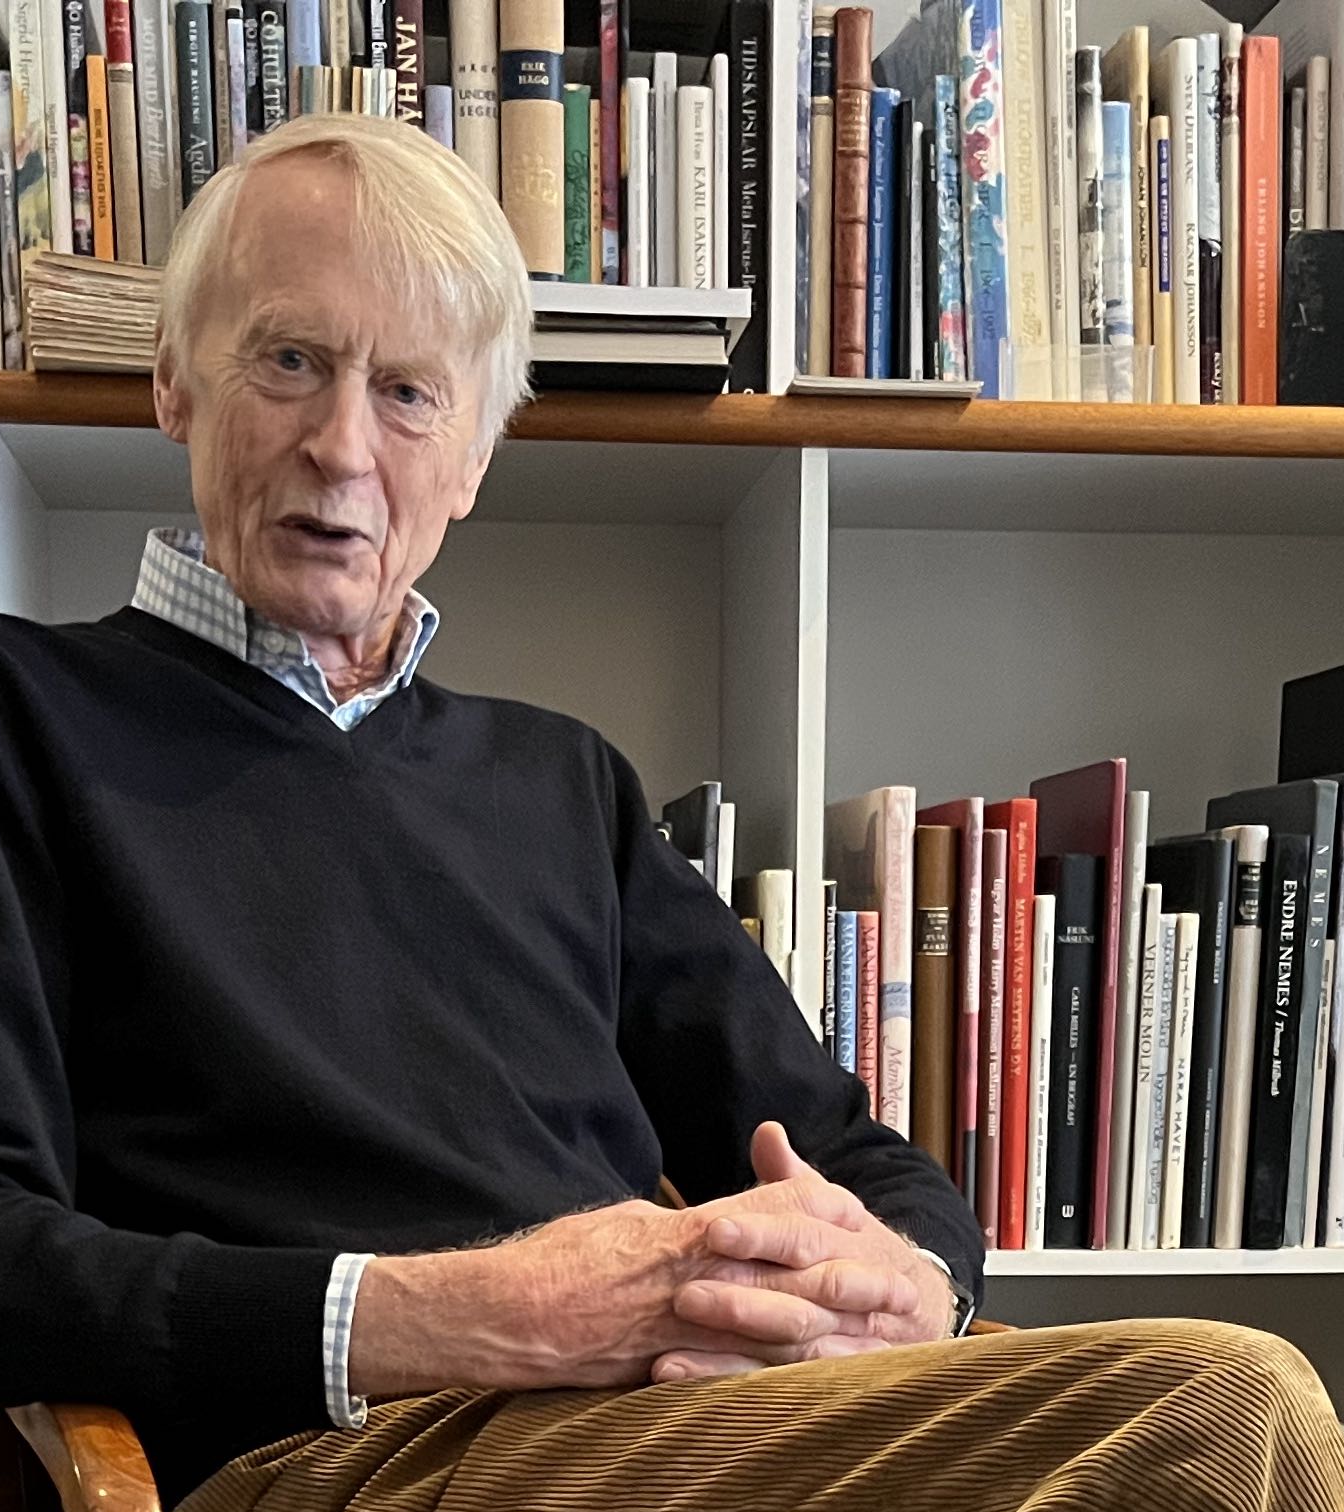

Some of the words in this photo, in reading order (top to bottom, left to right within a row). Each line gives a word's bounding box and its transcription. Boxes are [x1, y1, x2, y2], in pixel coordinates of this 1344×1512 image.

[17, 1, 35, 44] Sigrid
[395, 16, 417, 73] JAN
[190, 69, 200, 124] RAUSING
[741, 37, 758, 170] TIDSKAPSLAR
[185, 133, 209, 184] Agda
[694, 166, 707, 211] KARL
[741, 180, 757, 219] Meta
[693, 216, 706, 290] ISAKSON
[1014, 899, 1025, 952] MARTIN
[1281, 880, 1297, 941] ENDRE
[1309, 844, 1329, 950] NEMES
[861, 926, 876, 1054] MANDELGREN
[988, 959, 1000, 990] Harry
[1013, 956, 1024, 983] VAN
[1141, 944, 1156, 1019] VERNER
[1276, 945, 1294, 1006] NEMES
[988, 995, 1000, 1053] Martinson
[1139, 1025, 1153, 1084] MOLIN
